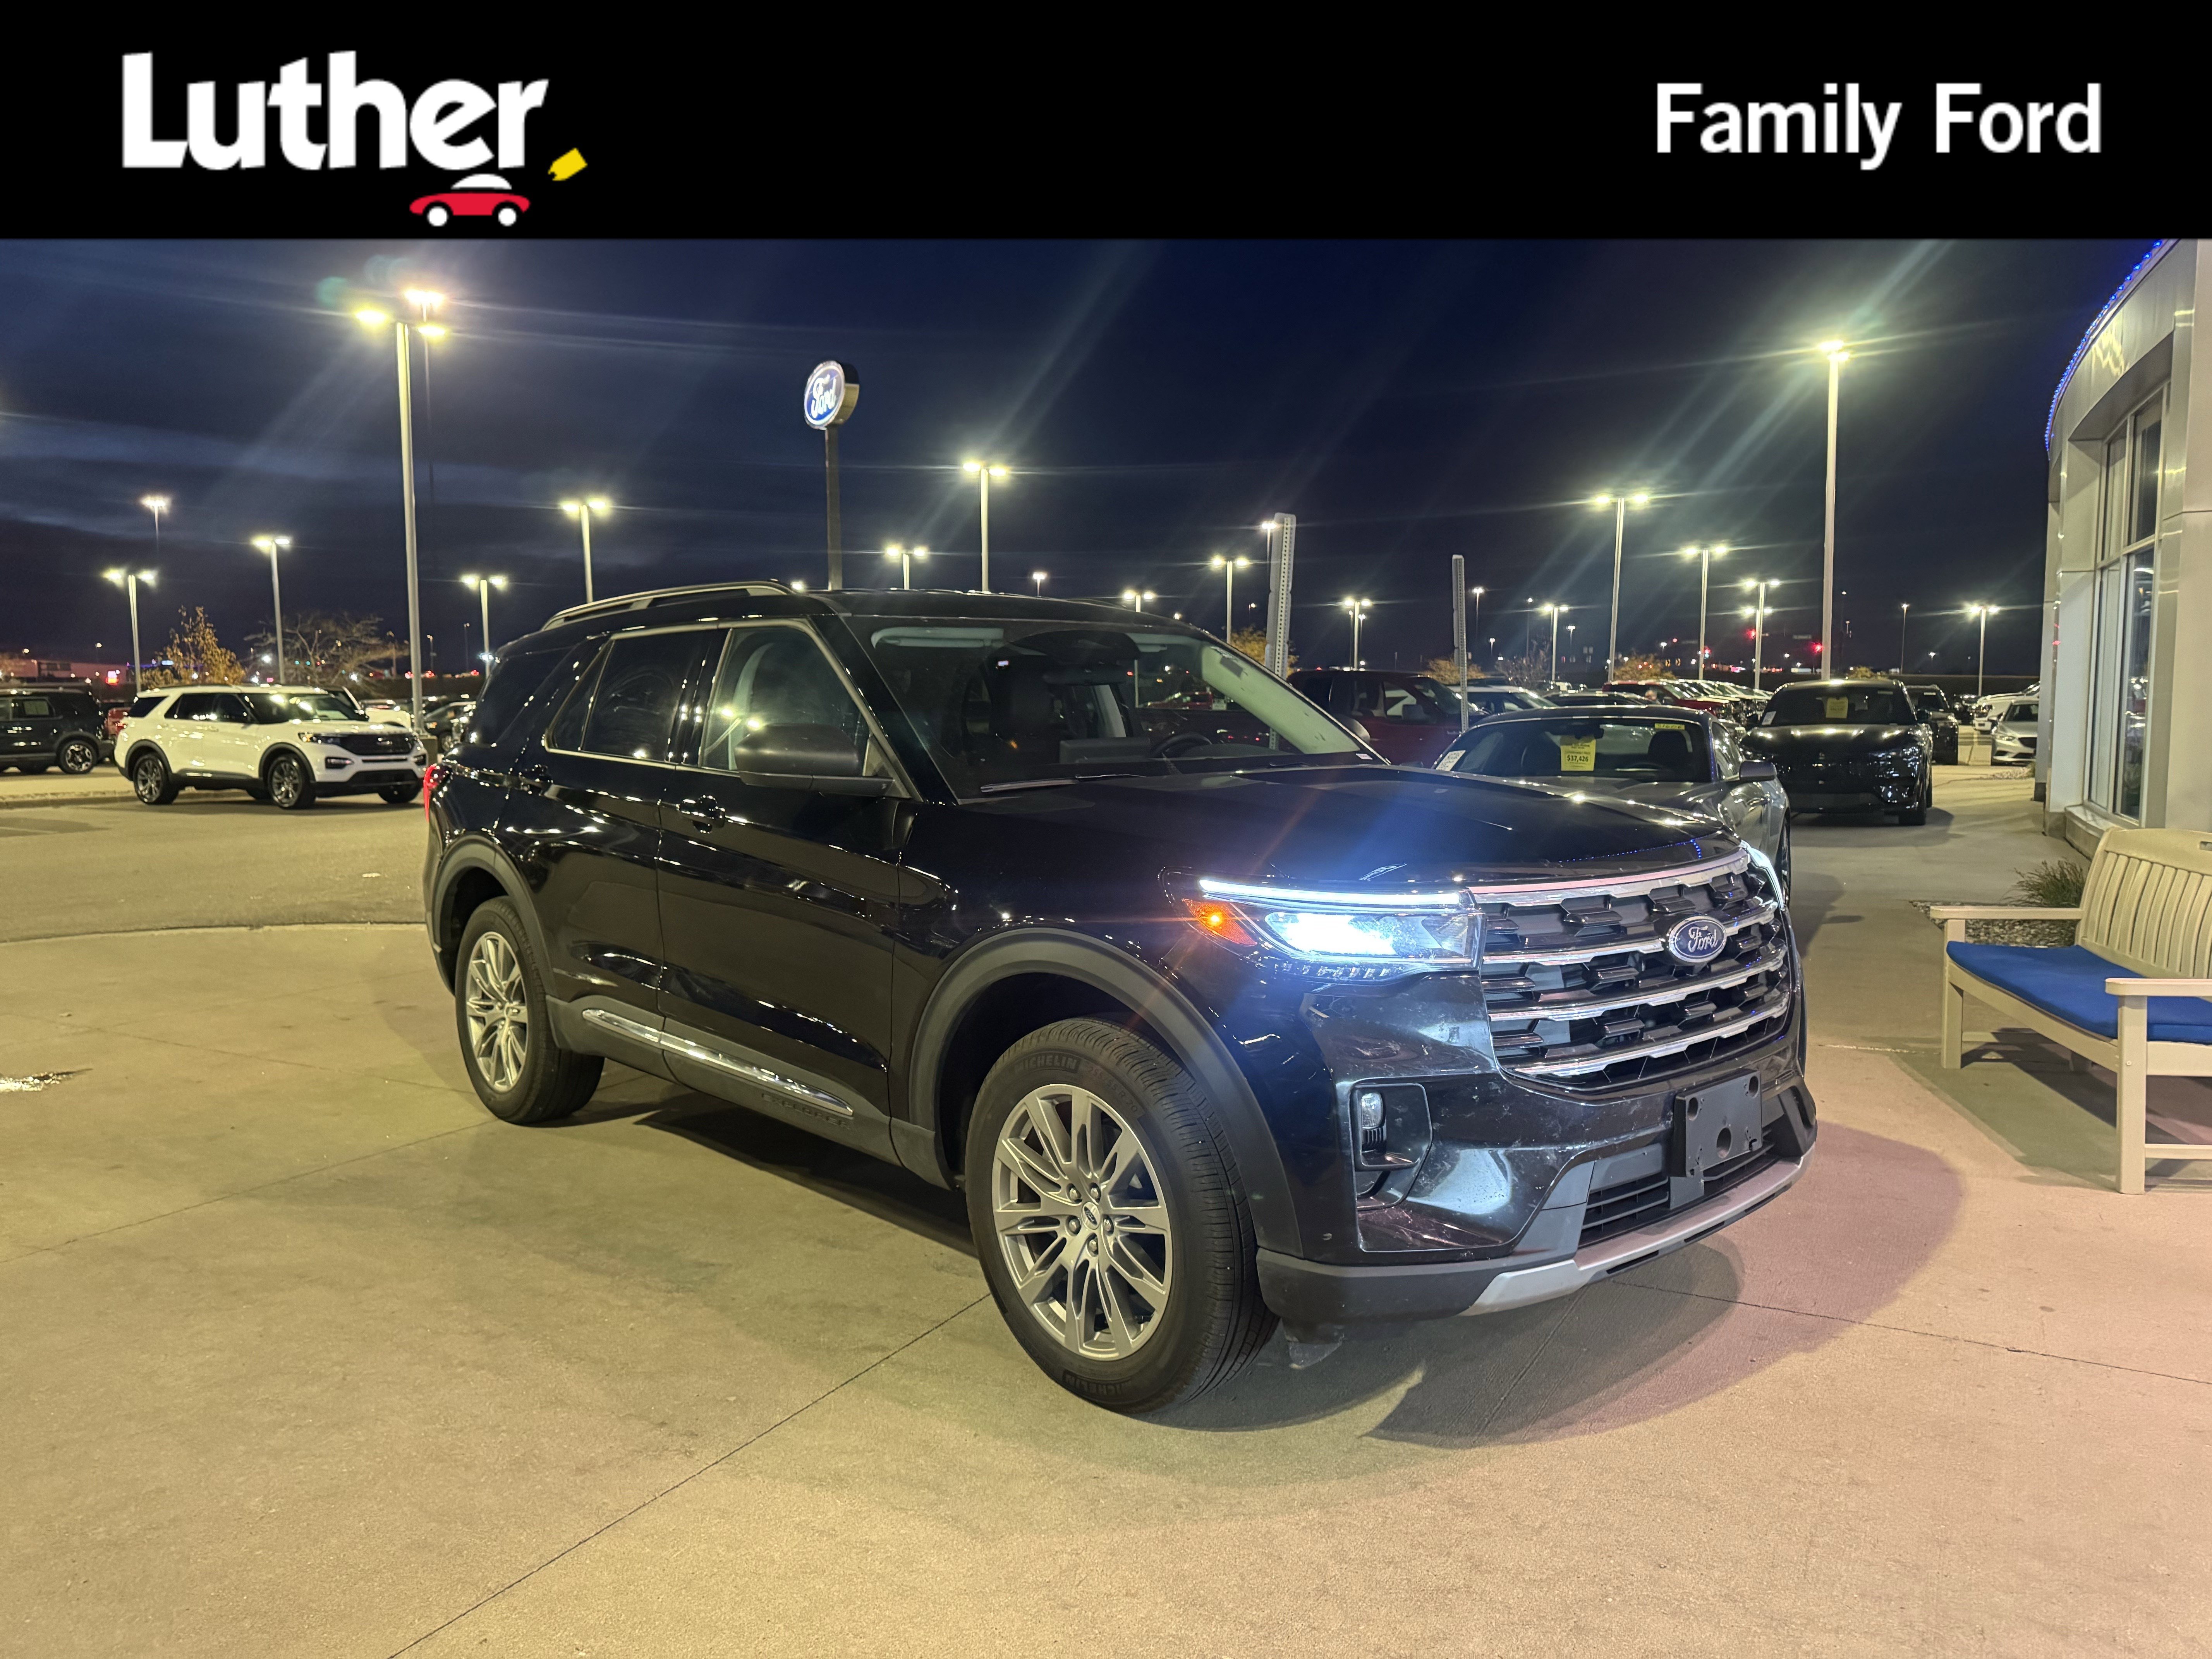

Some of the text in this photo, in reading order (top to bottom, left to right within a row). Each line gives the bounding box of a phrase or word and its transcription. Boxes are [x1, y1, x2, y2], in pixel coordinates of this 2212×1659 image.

[811, 374, 836, 418] Ford
[1688, 925, 1718, 953] Ford
[1014, 1055, 1078, 1073] MICHELIN
[762, 1093, 851, 1130] EXPLORER
